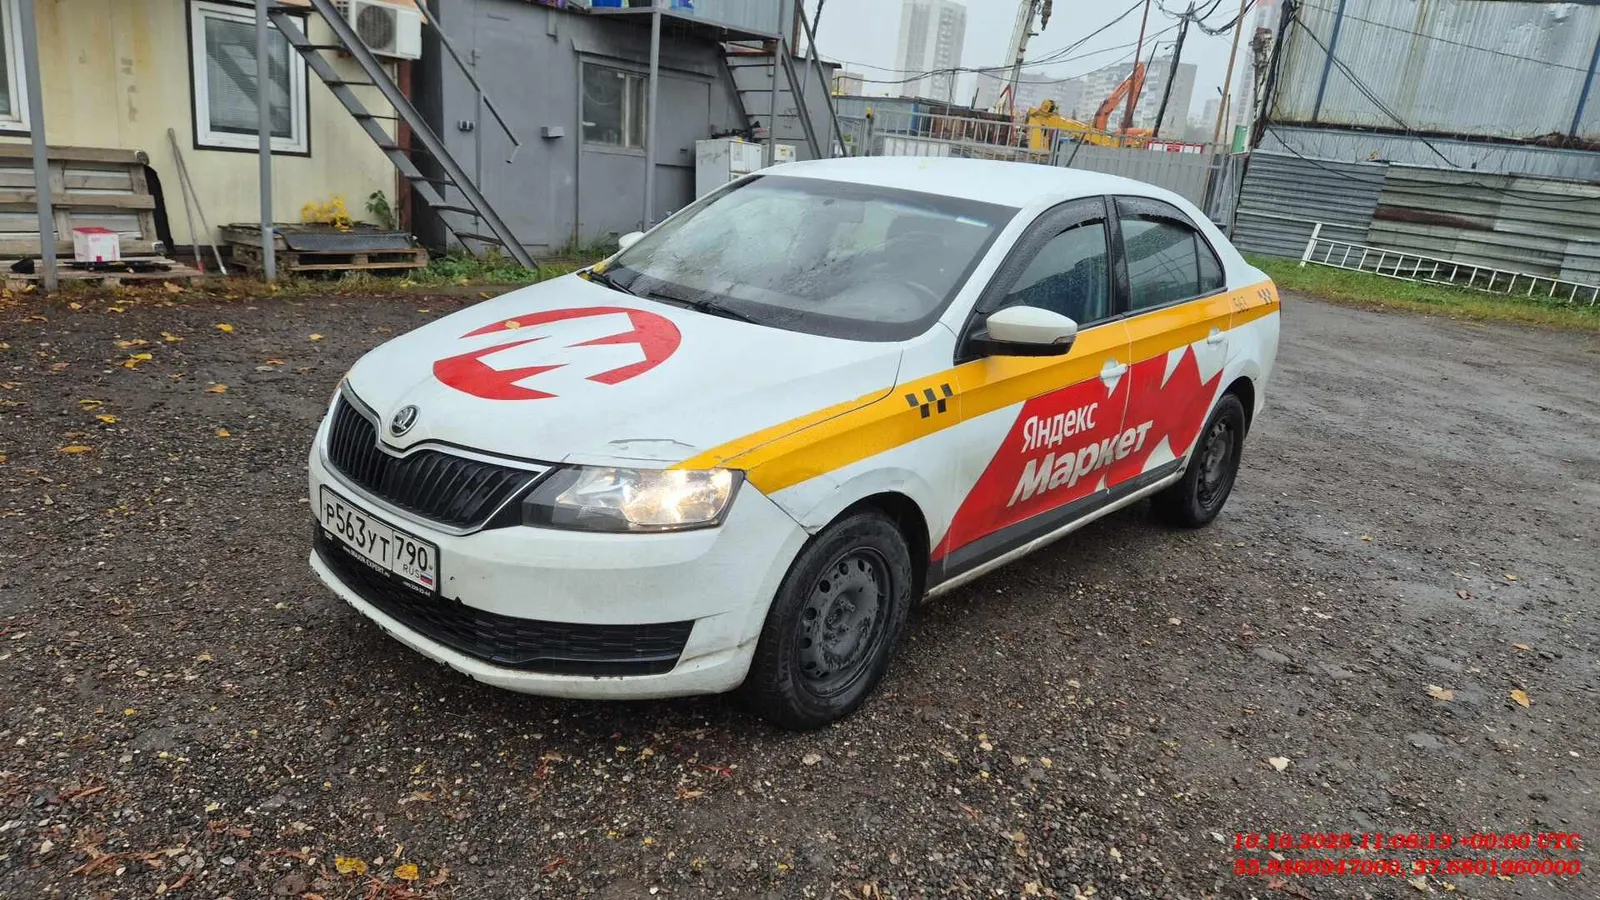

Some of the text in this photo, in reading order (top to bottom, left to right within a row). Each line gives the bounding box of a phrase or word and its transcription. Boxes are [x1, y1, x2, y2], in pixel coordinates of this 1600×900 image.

[1021, 402, 1098, 453] Яндекс
[1006, 421, 1153, 508] Маркет
[395, 536, 428, 571] 790
[402, 563, 420, 579] RUS
